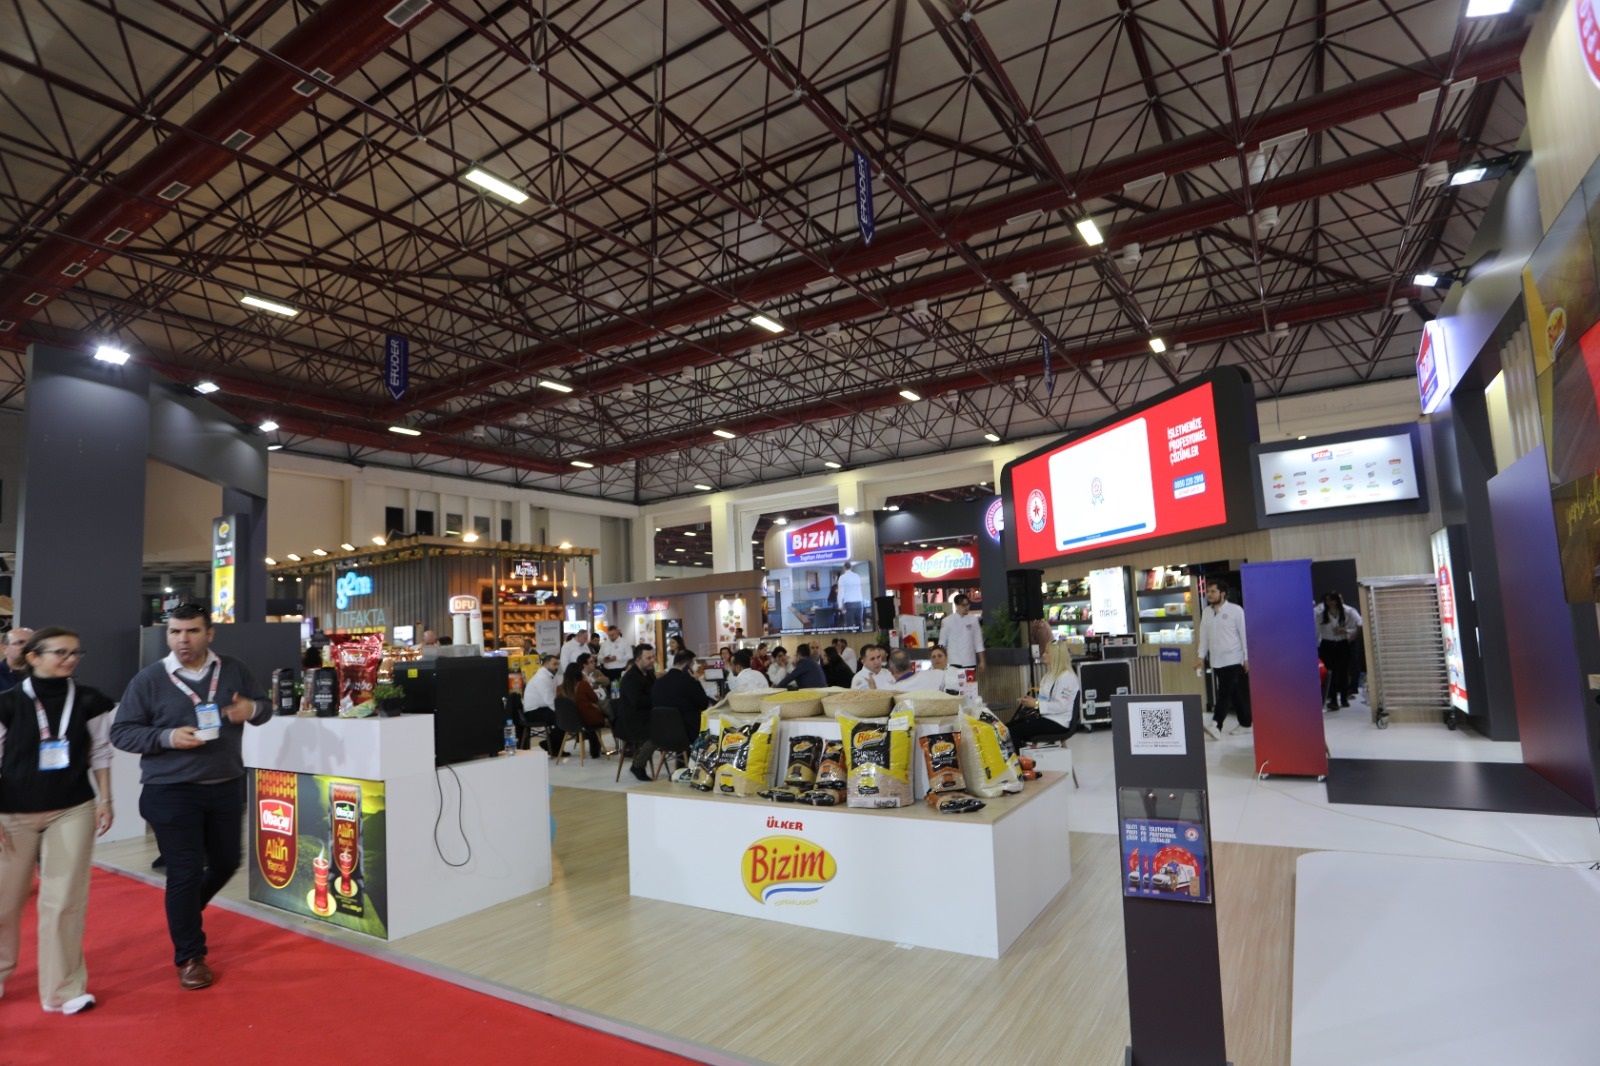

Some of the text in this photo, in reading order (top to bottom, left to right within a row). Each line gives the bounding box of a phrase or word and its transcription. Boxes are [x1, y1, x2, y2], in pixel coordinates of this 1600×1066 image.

[911, 553, 973, 572] SuperFresh
[263, 810, 290, 830] Obaçay
[766, 816, 803, 831] ÜLKER
[748, 844, 827, 883] Bizim
